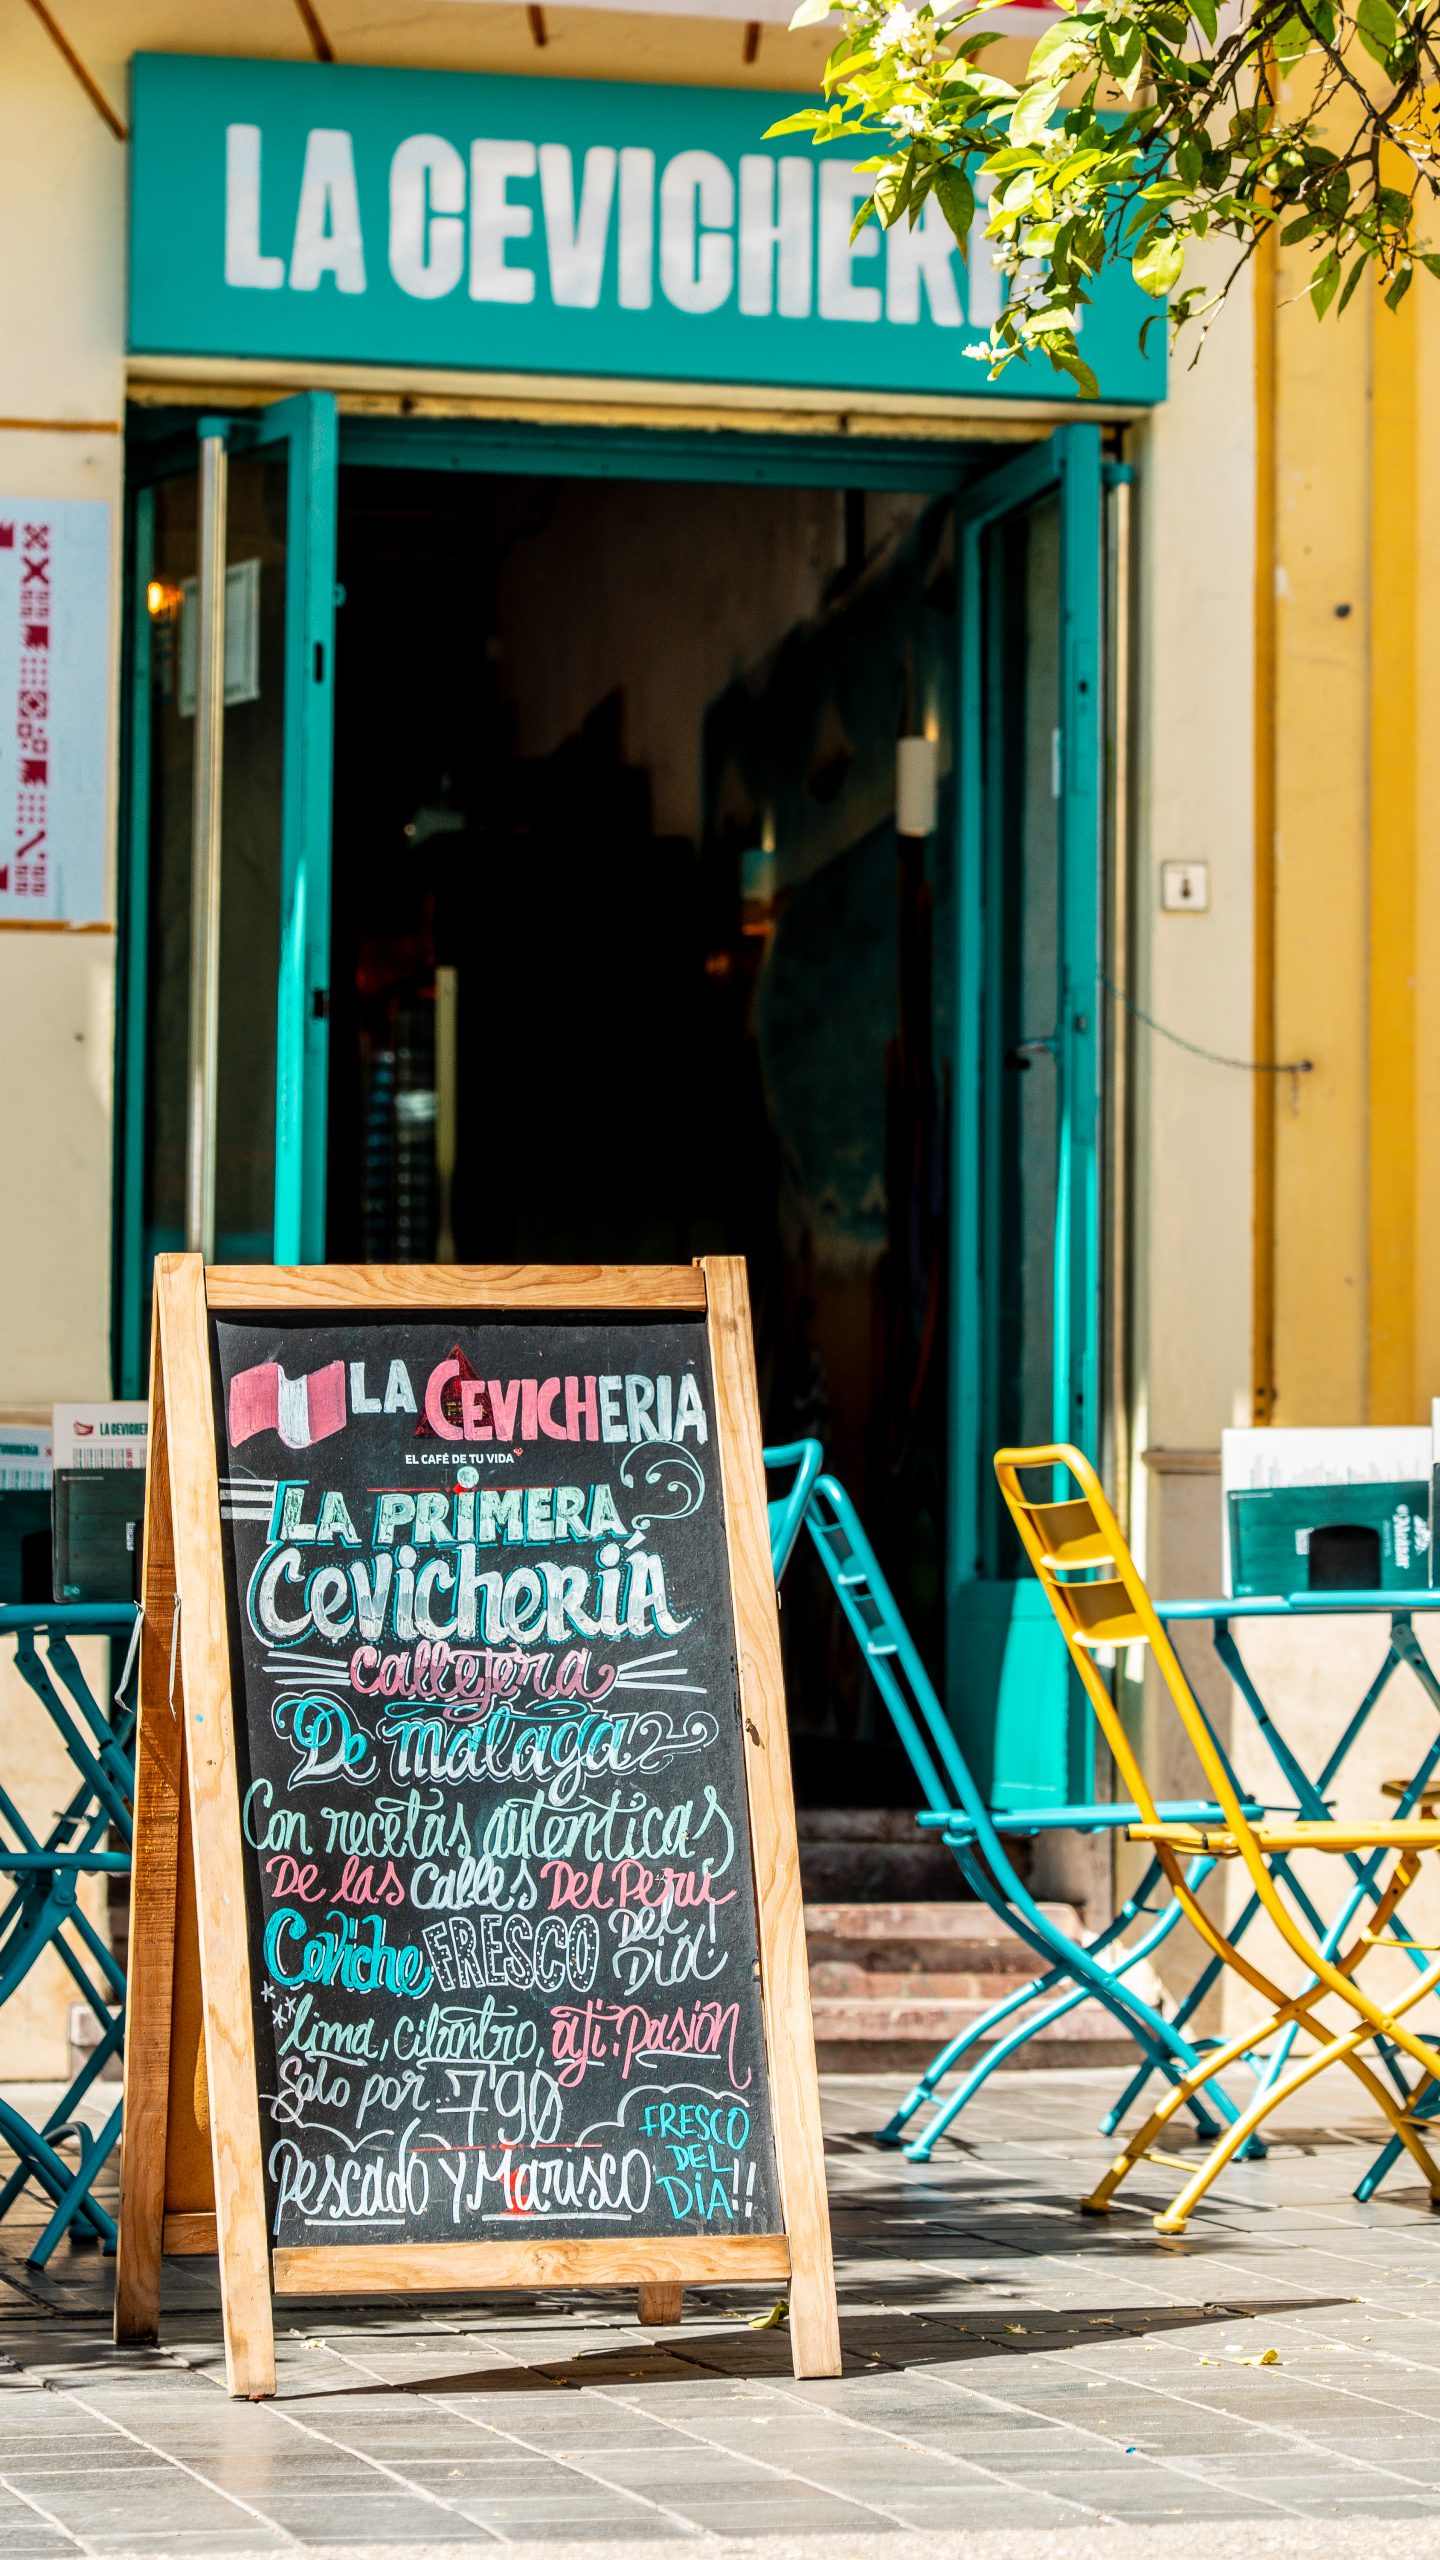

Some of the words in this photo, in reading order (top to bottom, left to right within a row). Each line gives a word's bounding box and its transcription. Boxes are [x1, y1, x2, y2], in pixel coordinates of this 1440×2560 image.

[226, 122, 366, 295] LA
[350, 1359, 418, 1414] LA
[424, 1359, 709, 1444] CEVICHERIA
[405, 1454, 420, 1465] EL
[451, 1454, 467, 1464] DE
[468, 1454, 484, 1464] TU
[486, 1453, 515, 1464] VIDA
[269, 1481, 363, 1546] LA
[273, 1692, 378, 1788] De
[244, 1778, 313, 1853] Con
[320, 1788, 471, 1859] recetas
[266, 1855, 328, 1903] De
[330, 1856, 405, 1909] las
[541, 1857, 614, 1910] Del
[608, 1877, 689, 1948] Del
[422, 1914, 600, 1993] FRESCO
[268, 2056, 351, 2123] Solo
[638, 2103, 751, 2150] FRESCO
[664, 2144, 734, 2173] DEL
